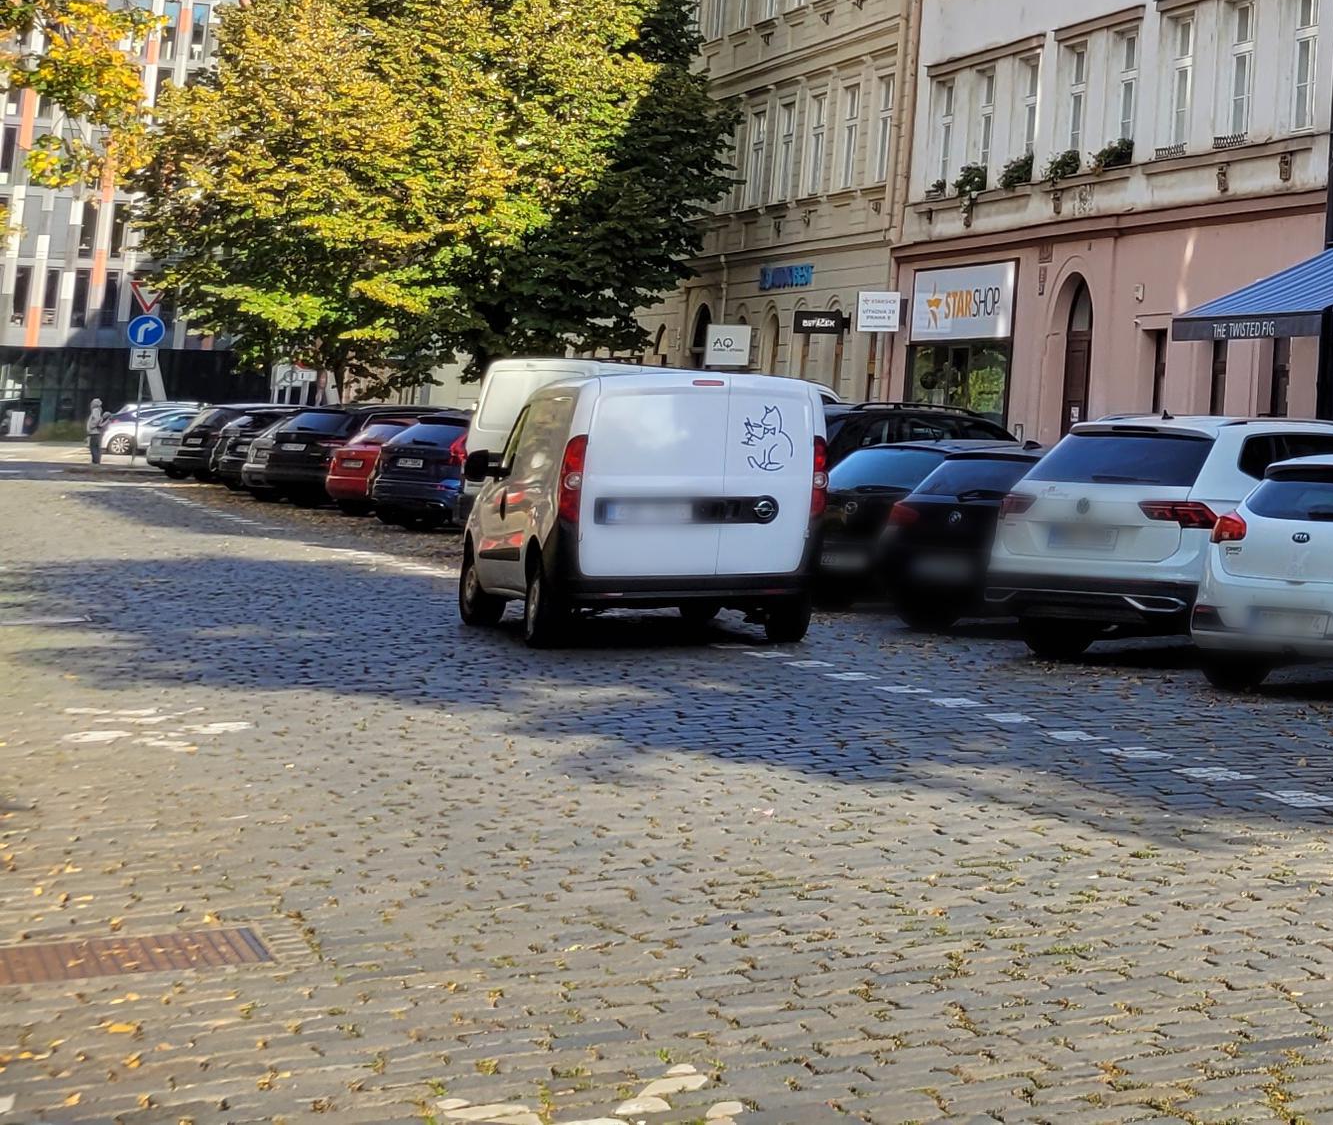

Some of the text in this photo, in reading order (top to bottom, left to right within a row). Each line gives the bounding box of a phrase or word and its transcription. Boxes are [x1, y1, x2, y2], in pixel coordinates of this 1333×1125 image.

[1213, 321, 1275, 338] THE TWISTED FIG
